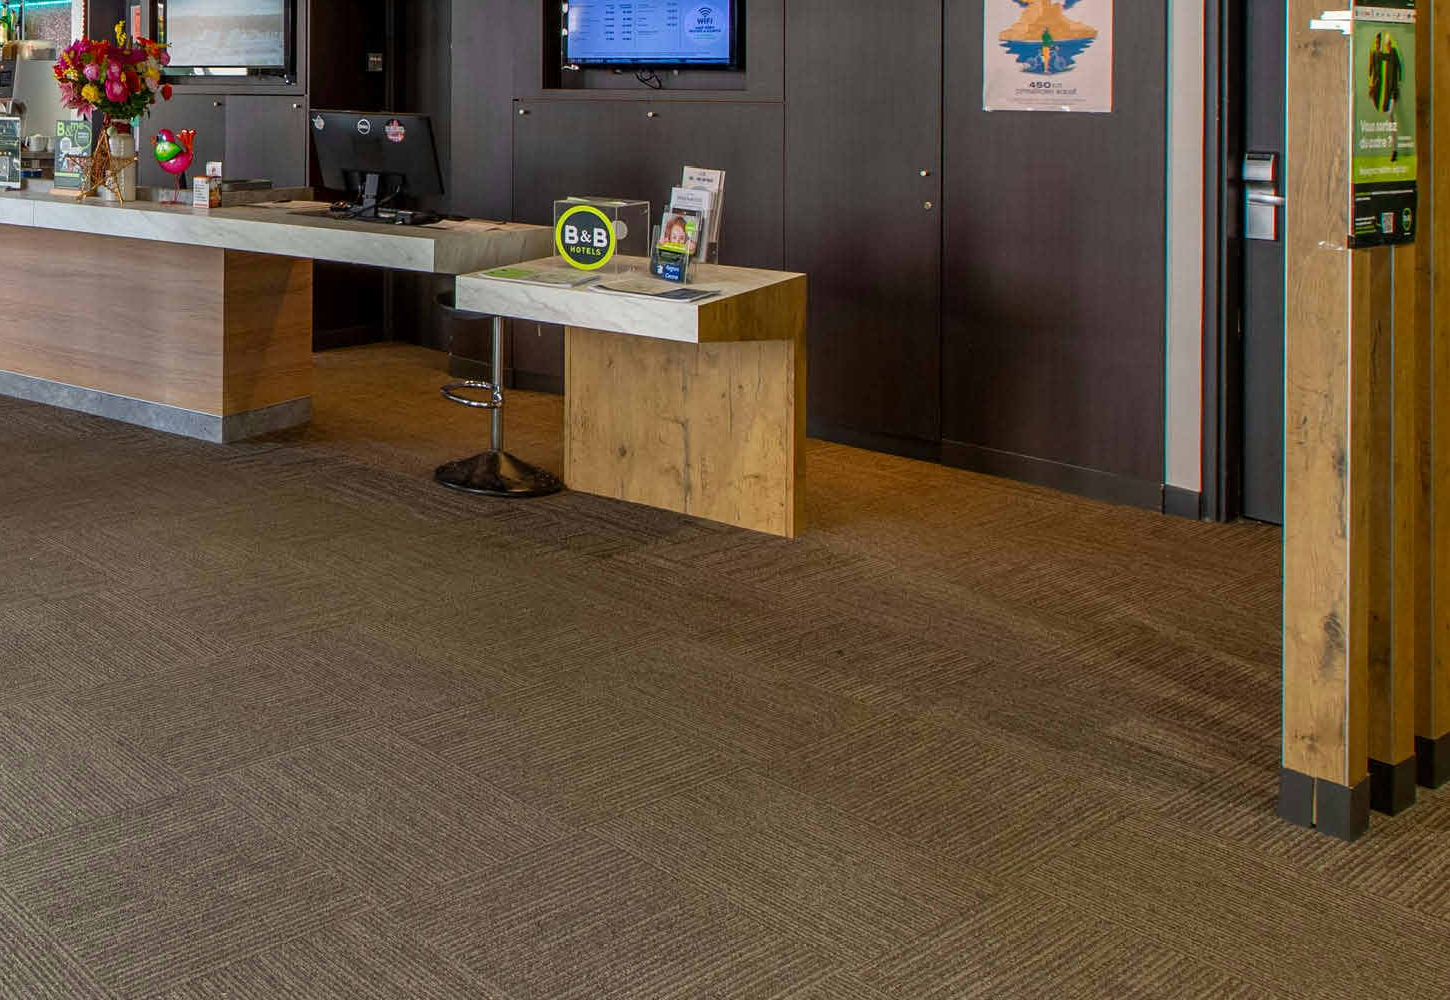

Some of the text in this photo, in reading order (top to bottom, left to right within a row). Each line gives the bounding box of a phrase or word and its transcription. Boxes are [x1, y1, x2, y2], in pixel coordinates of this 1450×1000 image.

[1029, 81, 1051, 89] 450
[564, 224, 608, 248] B&B
[569, 245, 602, 256] HOTELS
